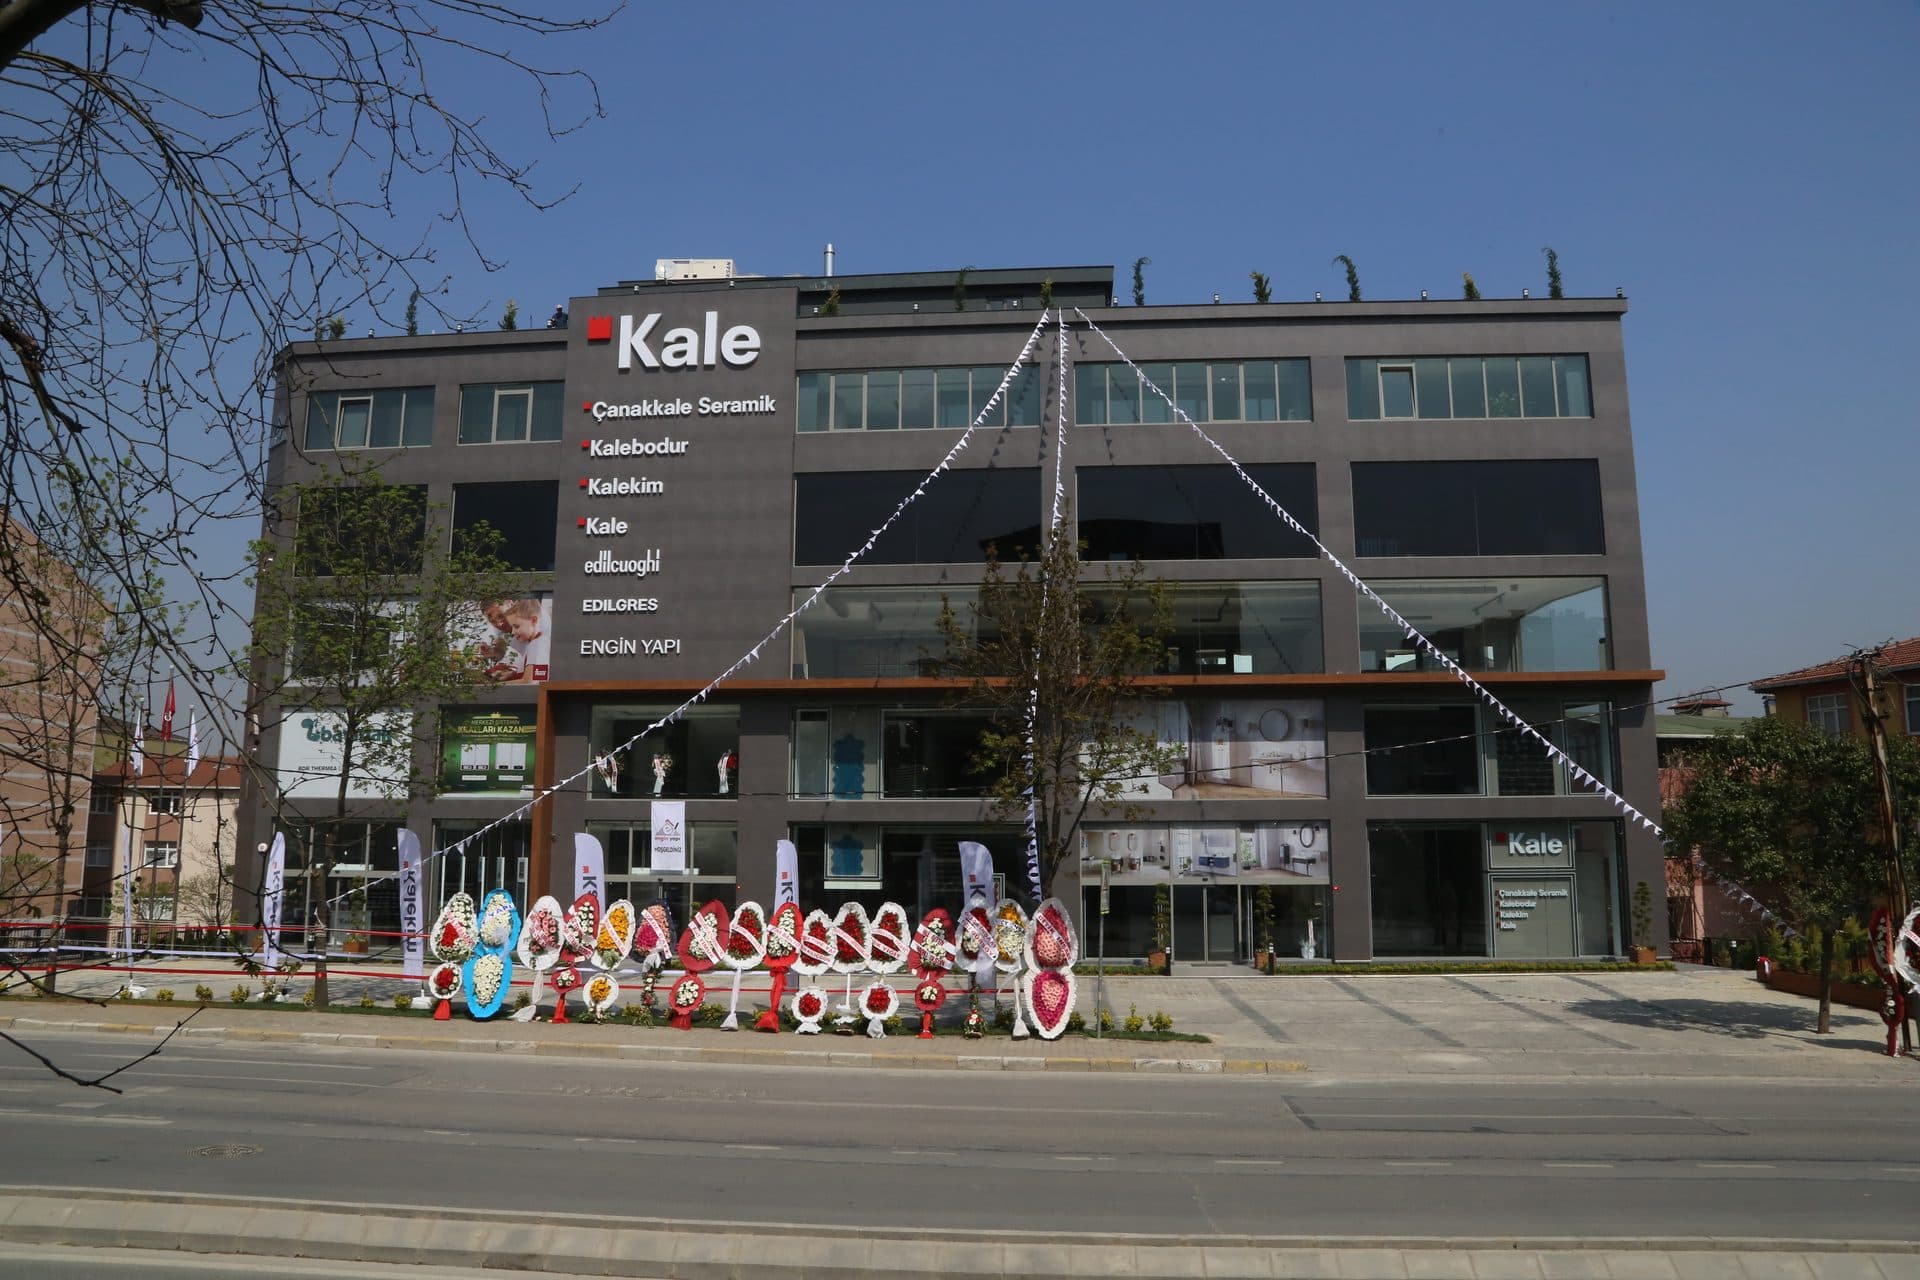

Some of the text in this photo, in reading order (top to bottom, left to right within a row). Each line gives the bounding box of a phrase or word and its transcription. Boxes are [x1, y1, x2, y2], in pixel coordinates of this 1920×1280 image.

[618, 311, 761, 369] Kale
[592, 395, 776, 421] Çanakkale Seramik
[590, 437, 688, 456] Kalebodur
[588, 477, 663, 495] Kalekim
[586, 517, 628, 535] Kale
[584, 549, 660, 577] edilcuoghi
[582, 598, 658, 612] EDILGRES
[580, 637, 680, 655] ENGİN YAPI
[1508, 832, 1563, 854] Kale
[1499, 888, 1568, 898] Çanakkale Seramik
